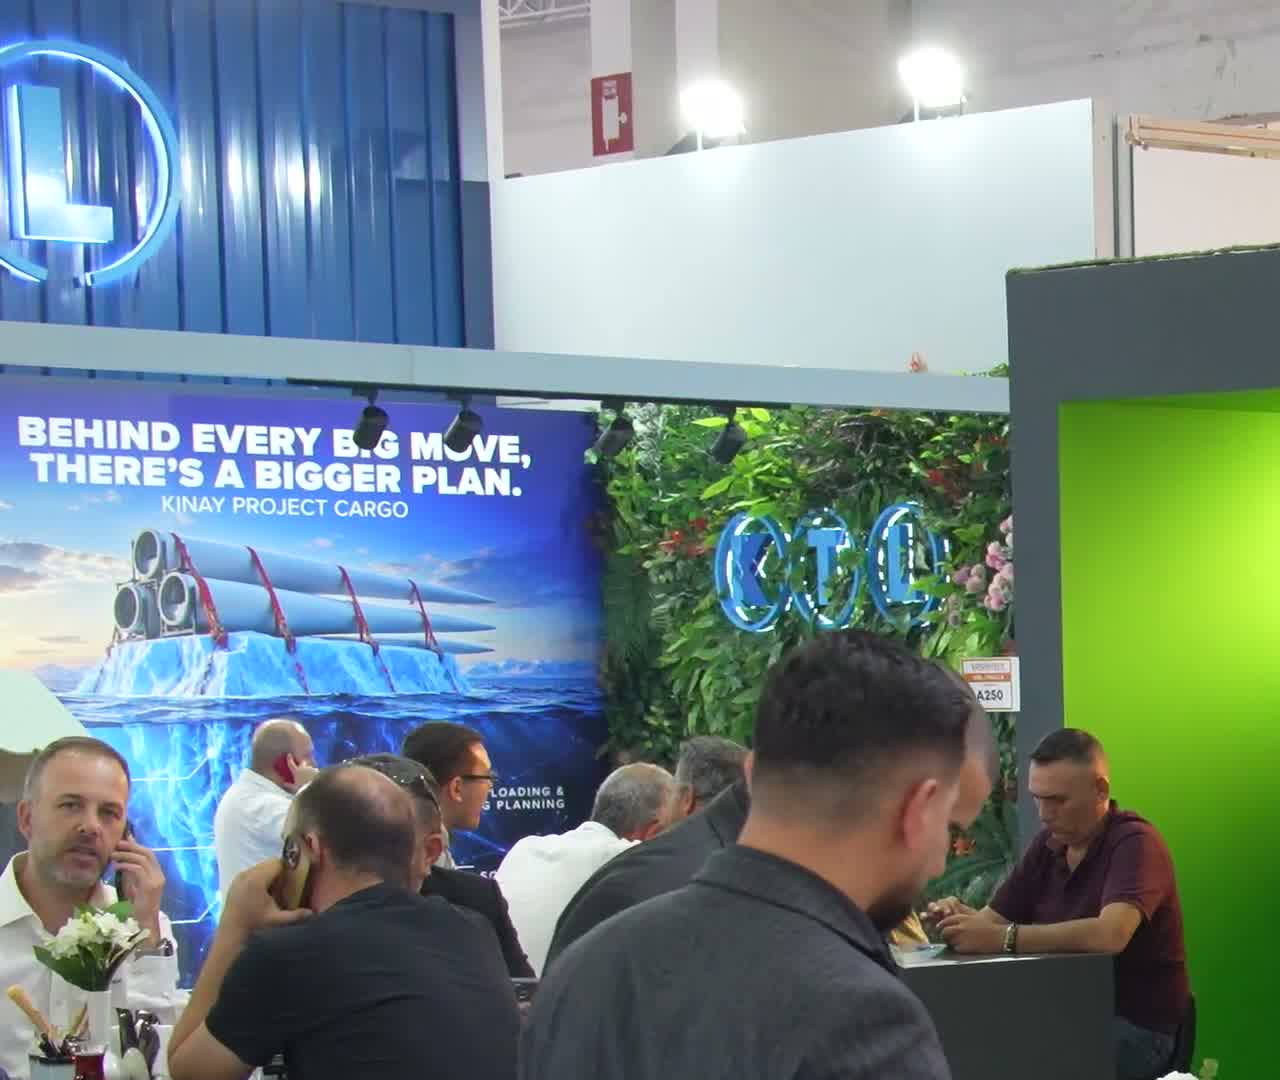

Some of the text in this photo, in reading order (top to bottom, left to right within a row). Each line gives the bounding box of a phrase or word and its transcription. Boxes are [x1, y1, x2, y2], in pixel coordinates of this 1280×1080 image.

[18, 415, 180, 452] BEHIND
[192, 423, 321, 456] EVERY
[333, 429, 399, 459] BG
[214, 458, 245, 489] A
[255, 460, 400, 493] BIGGER
[412, 466, 522, 497] PLAN.
[161, 495, 409, 518] KINAY PROJECT CARGO
[976, 689, 1003, 701] A250
[556, 785, 564, 796] &
[496, 799, 565, 811] PLANNING
